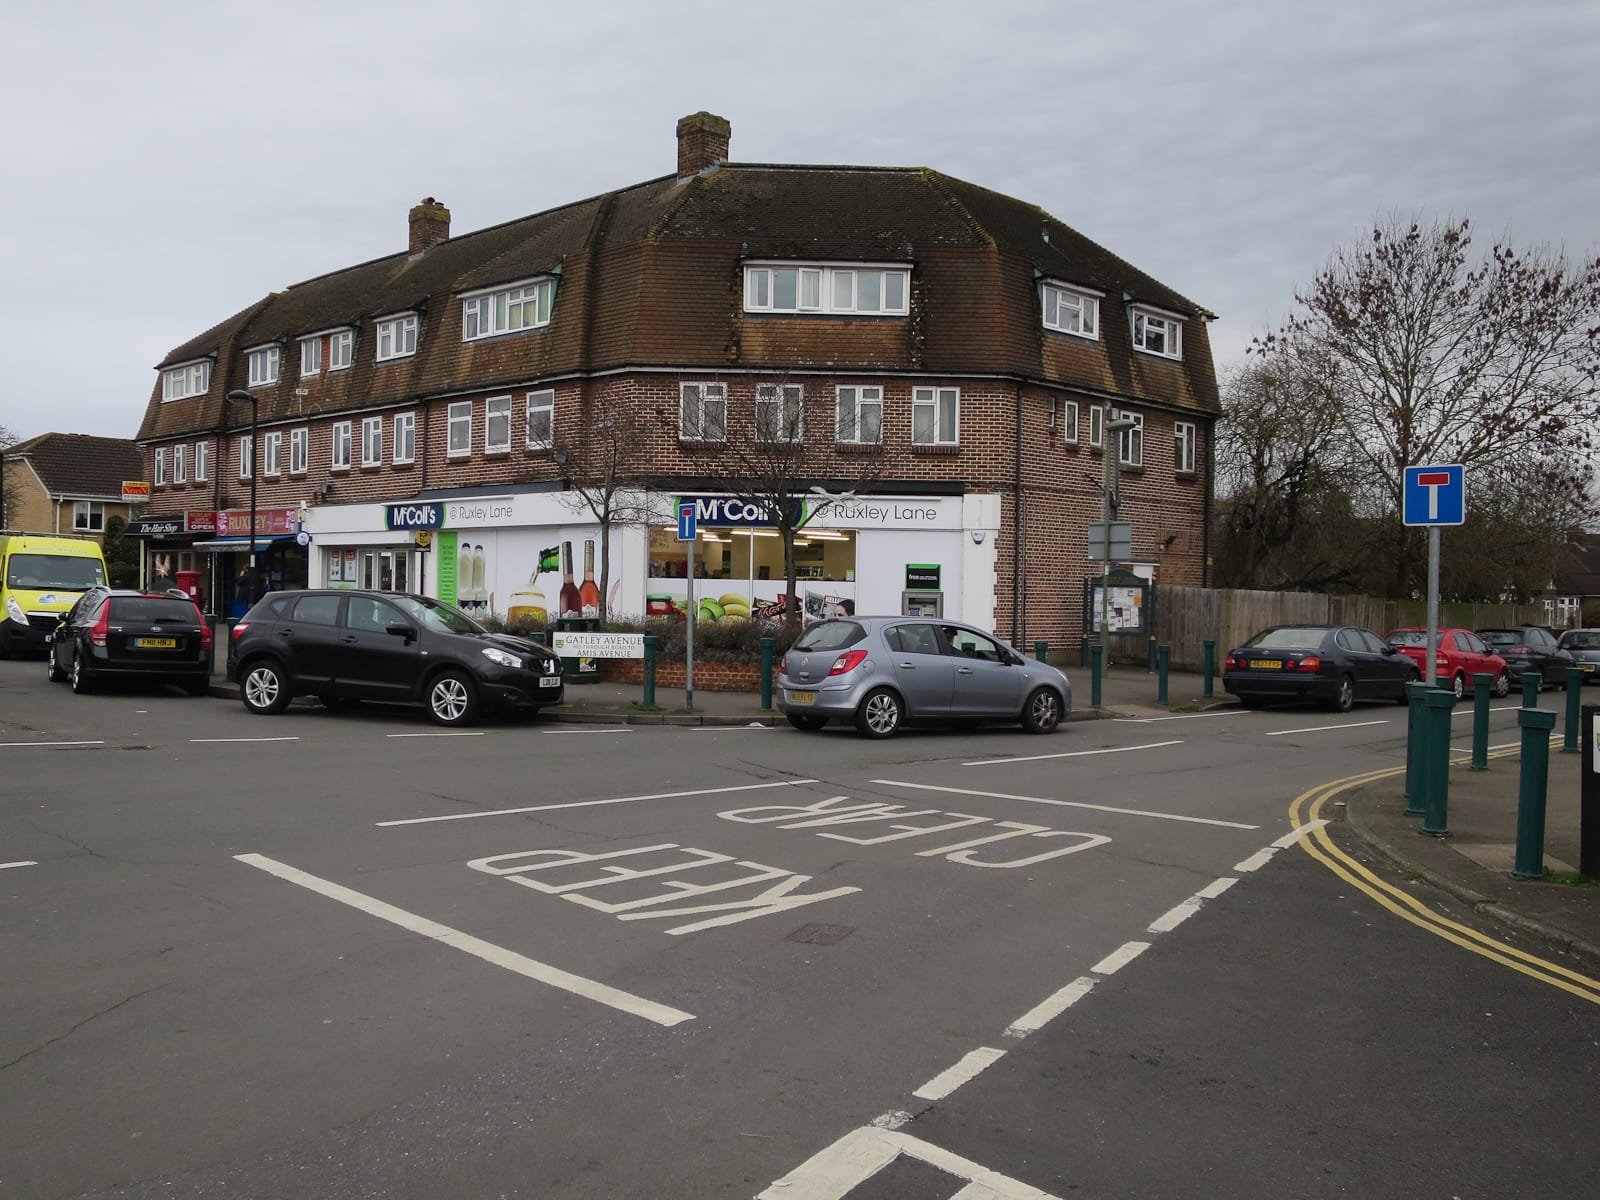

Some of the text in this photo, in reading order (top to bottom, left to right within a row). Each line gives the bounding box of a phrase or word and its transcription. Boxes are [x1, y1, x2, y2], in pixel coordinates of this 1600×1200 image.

[393, 505, 436, 526] McColl's
[459, 505, 488, 520] Ruxley
[489, 505, 513, 518] Lane
[834, 504, 889, 523] Ruxley
[894, 505, 937, 520] Lane
[140, 524, 151, 533] The
[566, 635, 643, 646] GATLEY AVENUE
[599, 650, 632, 658] AVENUE
[715, 796, 1112, 869] CLEAR
[466, 843, 862, 936] KEEP
